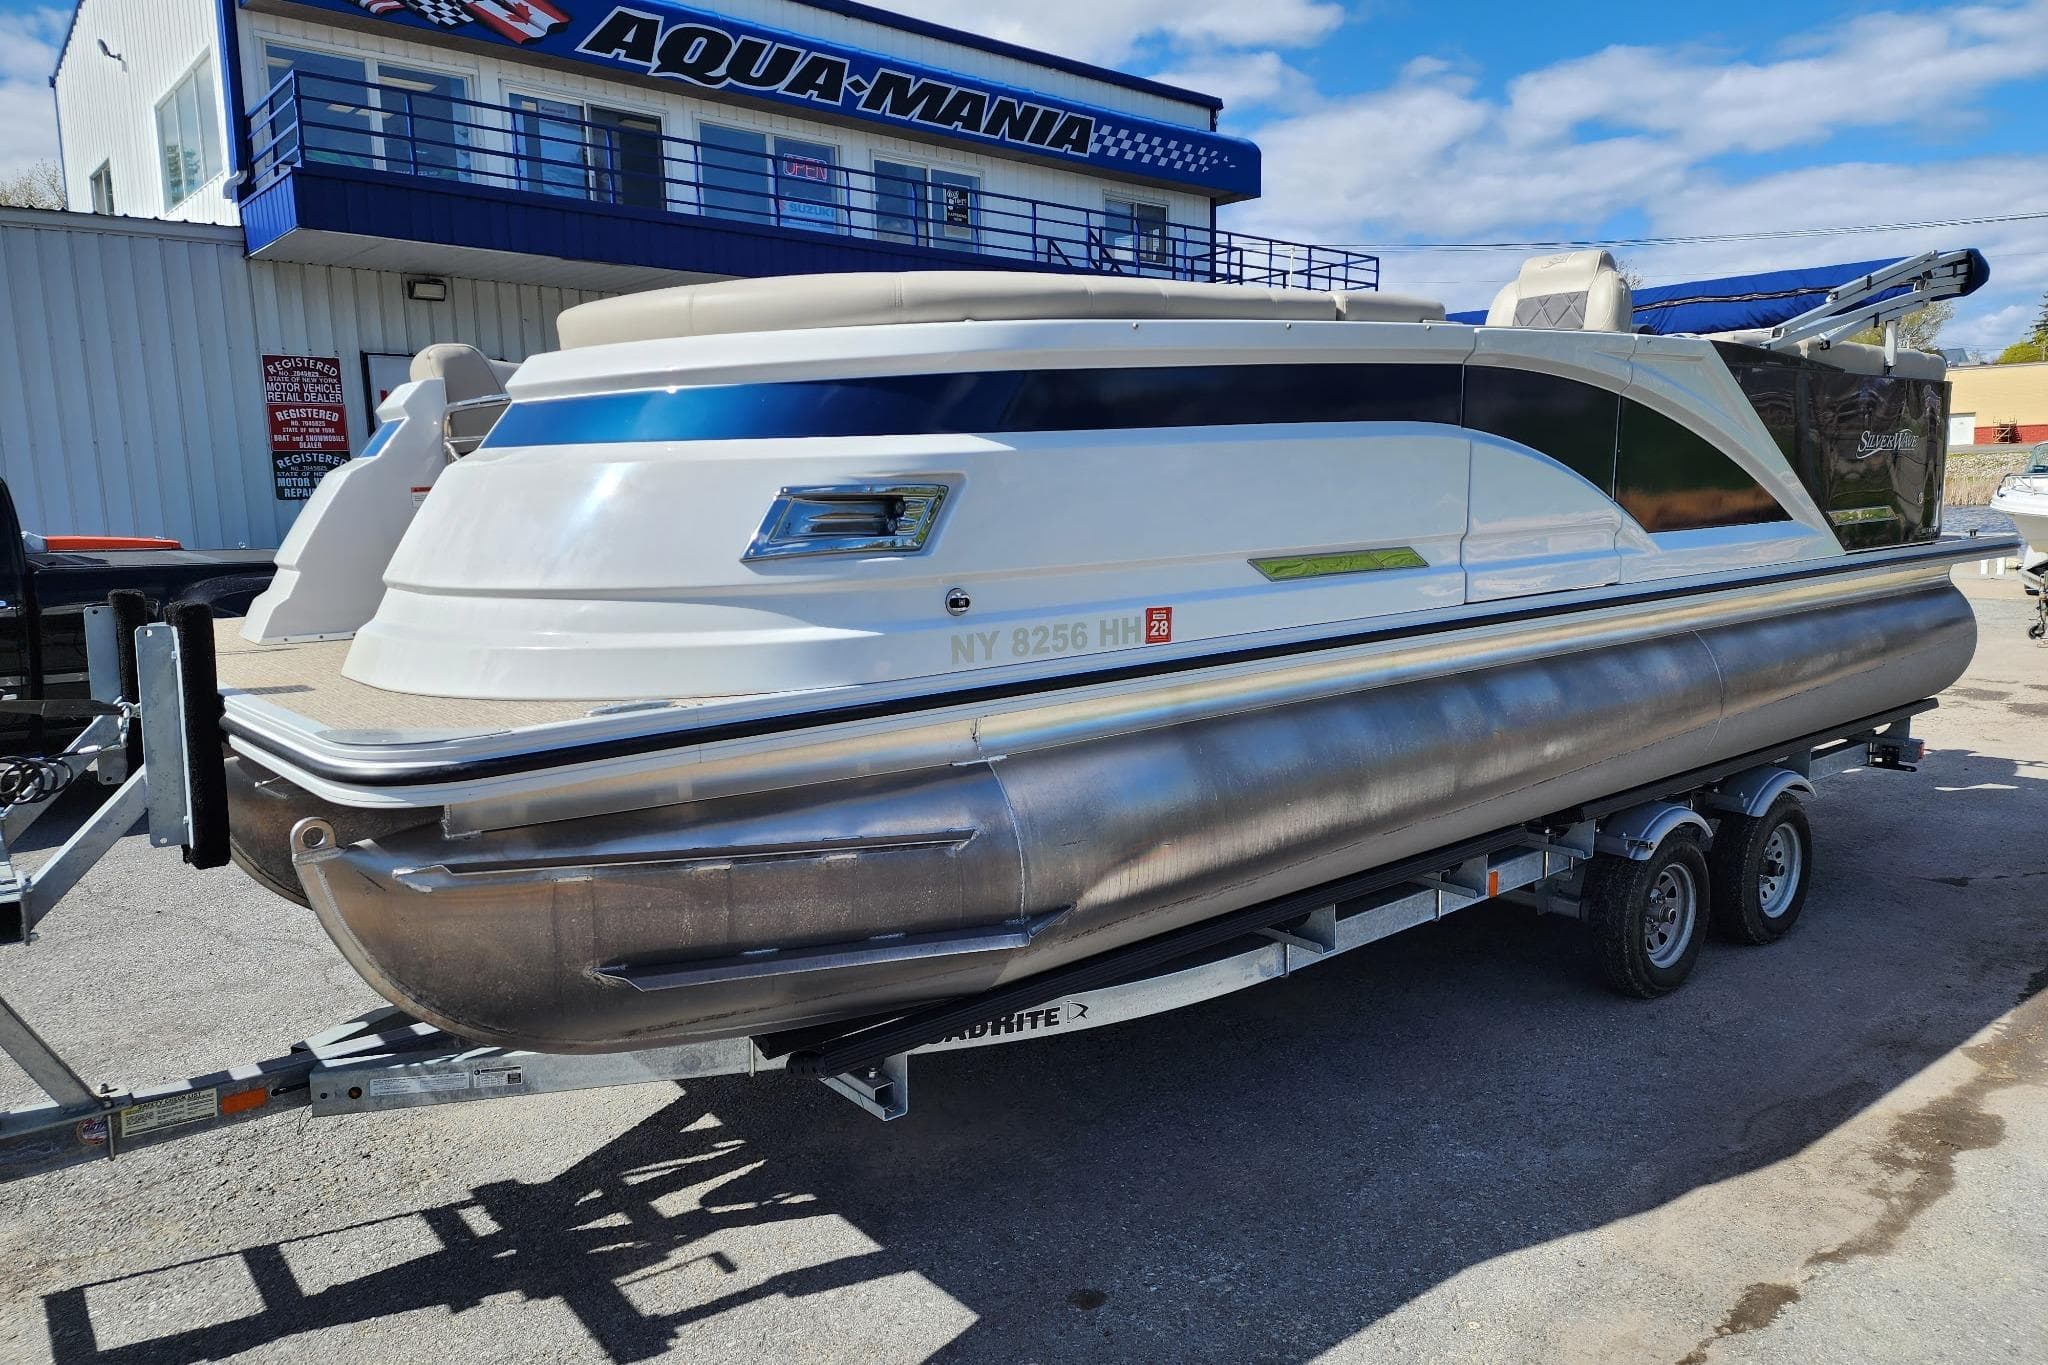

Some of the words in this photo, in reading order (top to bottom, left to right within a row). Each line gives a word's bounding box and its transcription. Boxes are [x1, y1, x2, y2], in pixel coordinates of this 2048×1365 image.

[785, 157, 826, 180] OPEN
[790, 202, 833, 217] SUZUKI
[267, 358, 338, 376] REGISTERED
[266, 382, 301, 392] MOTOR
[302, 383, 342, 393] VEHICLE
[267, 391, 302, 402] RETAIL
[304, 393, 343, 403] DEALER
[275, 408, 339, 421] REGISTERED
[277, 477, 310, 487] MOTOR
[1150, 620, 1168, 636] 28
[951, 630, 1000, 665] NY
[1011, 621, 1089, 657] 8256
[1100, 616, 1142, 647] HH
